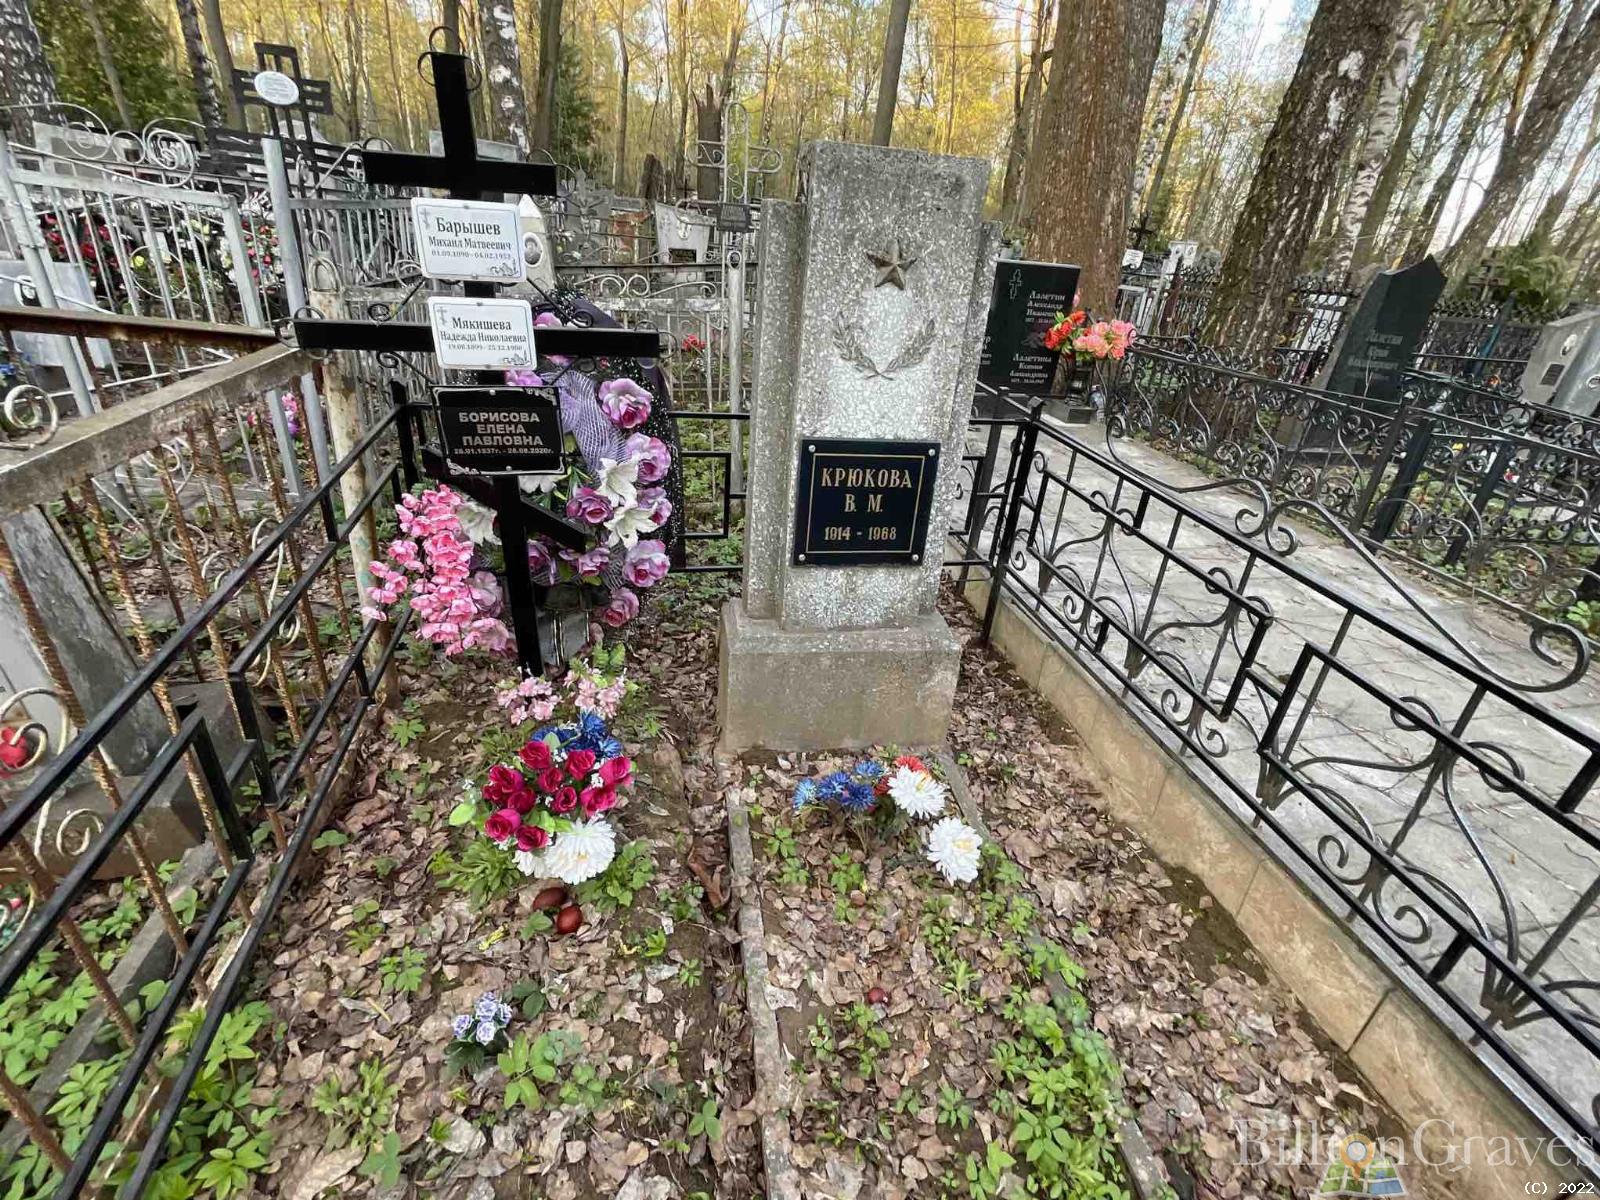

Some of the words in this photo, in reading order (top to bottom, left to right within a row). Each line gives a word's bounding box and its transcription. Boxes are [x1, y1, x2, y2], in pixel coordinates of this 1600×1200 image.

[436, 217, 501, 237] Барышев
[428, 236, 463, 248] Михаил
[464, 238, 512, 250] Матвеевич
[451, 317, 512, 331] Мякишева
[440, 331, 477, 342] Надежда
[478, 332, 527, 343] Николаевна
[459, 412, 540, 422] БОРИСОВА
[476, 424, 526, 434] ЕЛЕНА
[462, 436, 543, 446] ПАВЛОВНА
[821, 467, 913, 489] КРЮКОВА
[844, 493, 857, 513] В.
[867, 493, 883, 513] М.
[824, 526, 851, 541] 1914
[868, 526, 897, 541] 1968
